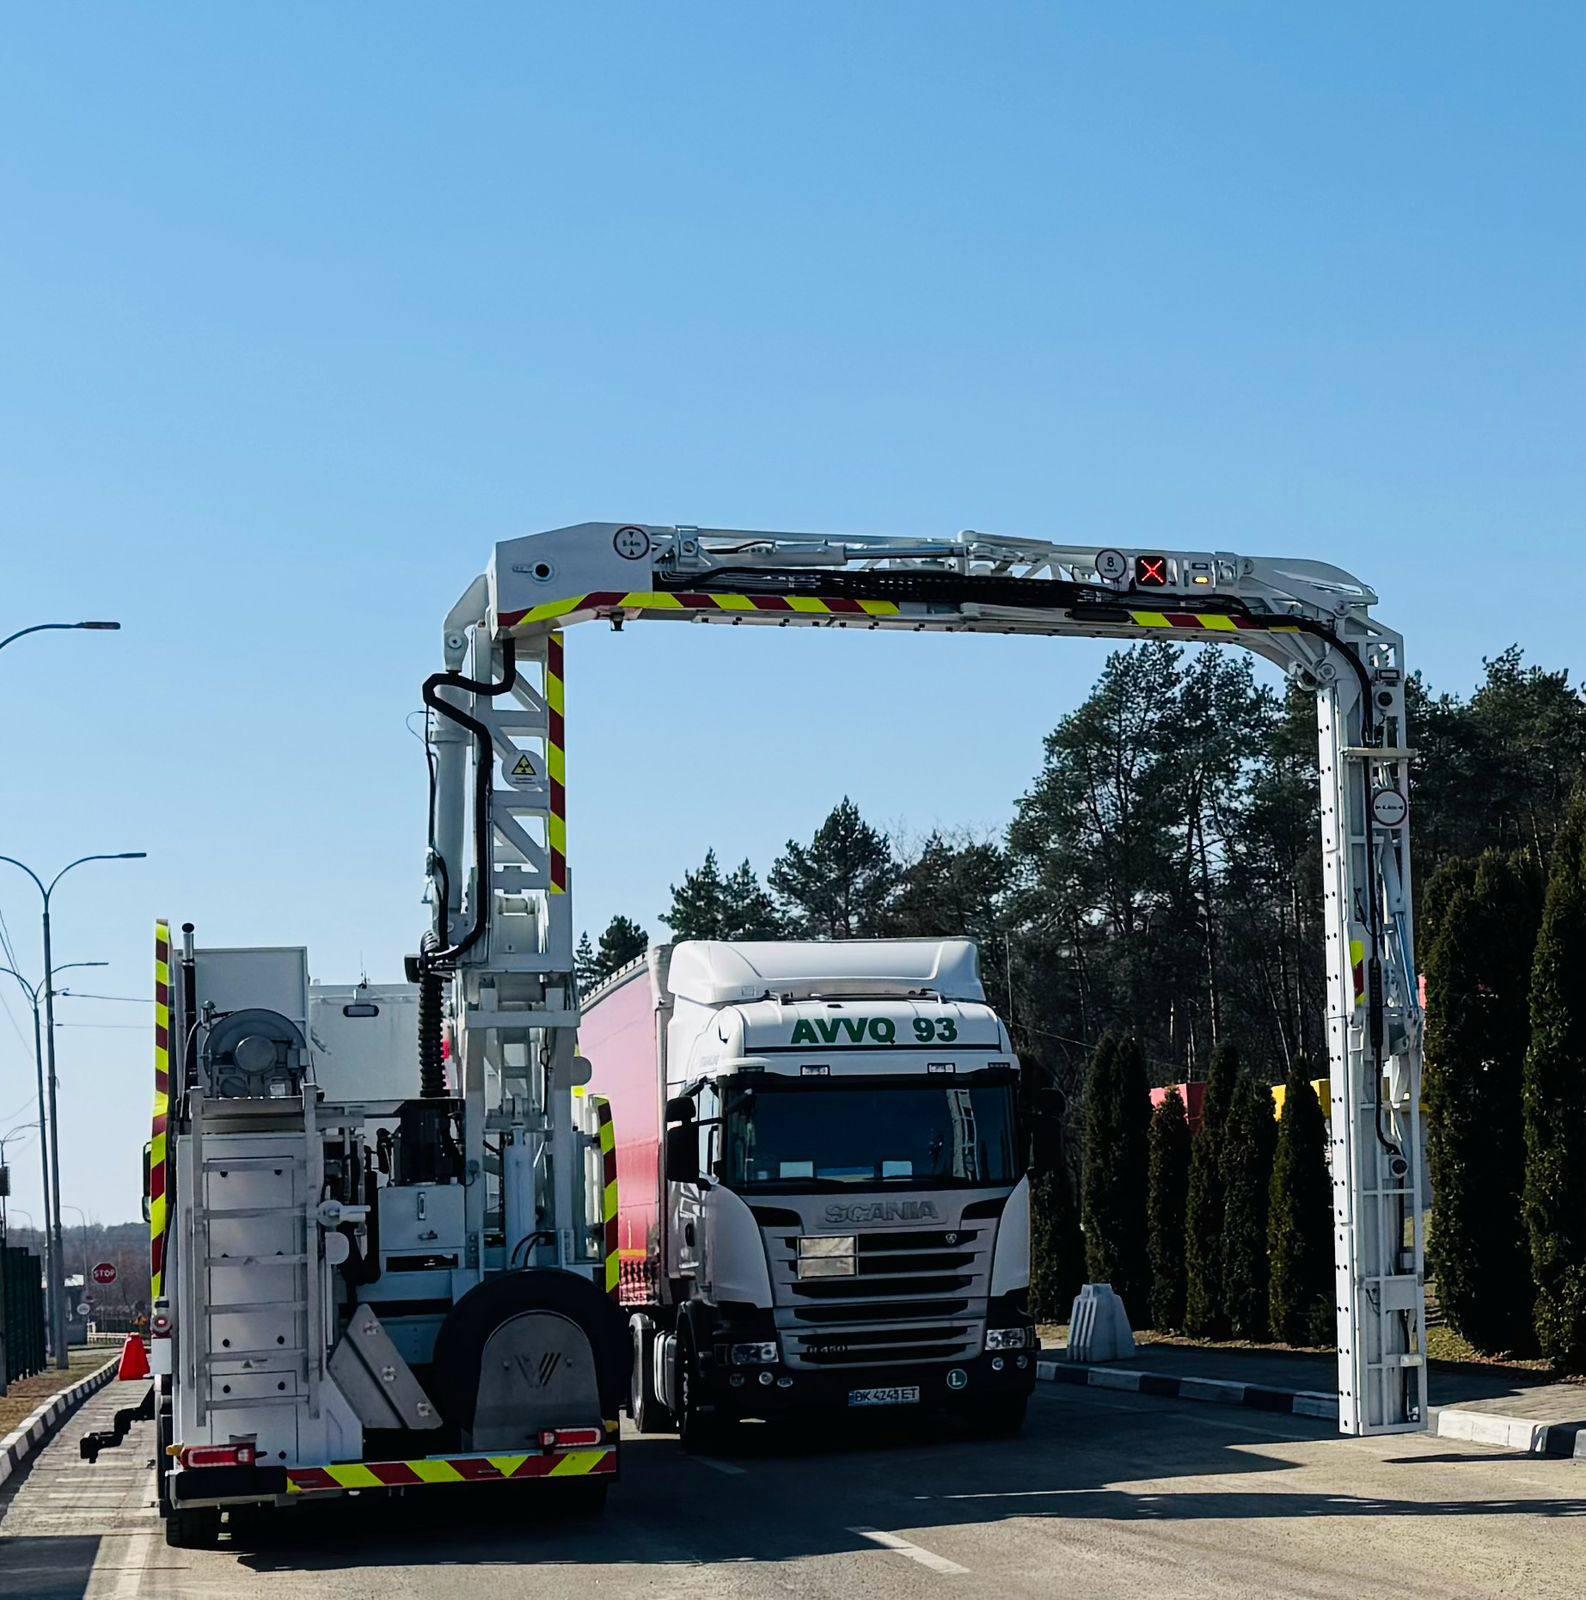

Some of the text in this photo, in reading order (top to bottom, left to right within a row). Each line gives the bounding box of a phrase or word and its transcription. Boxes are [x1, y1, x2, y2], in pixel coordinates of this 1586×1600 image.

[1106, 556, 1115, 568] 8
[791, 1017, 958, 1045] AVVQ 93
[824, 1201, 939, 1223] SCANIA
[93, 1269, 116, 1277] STOP
